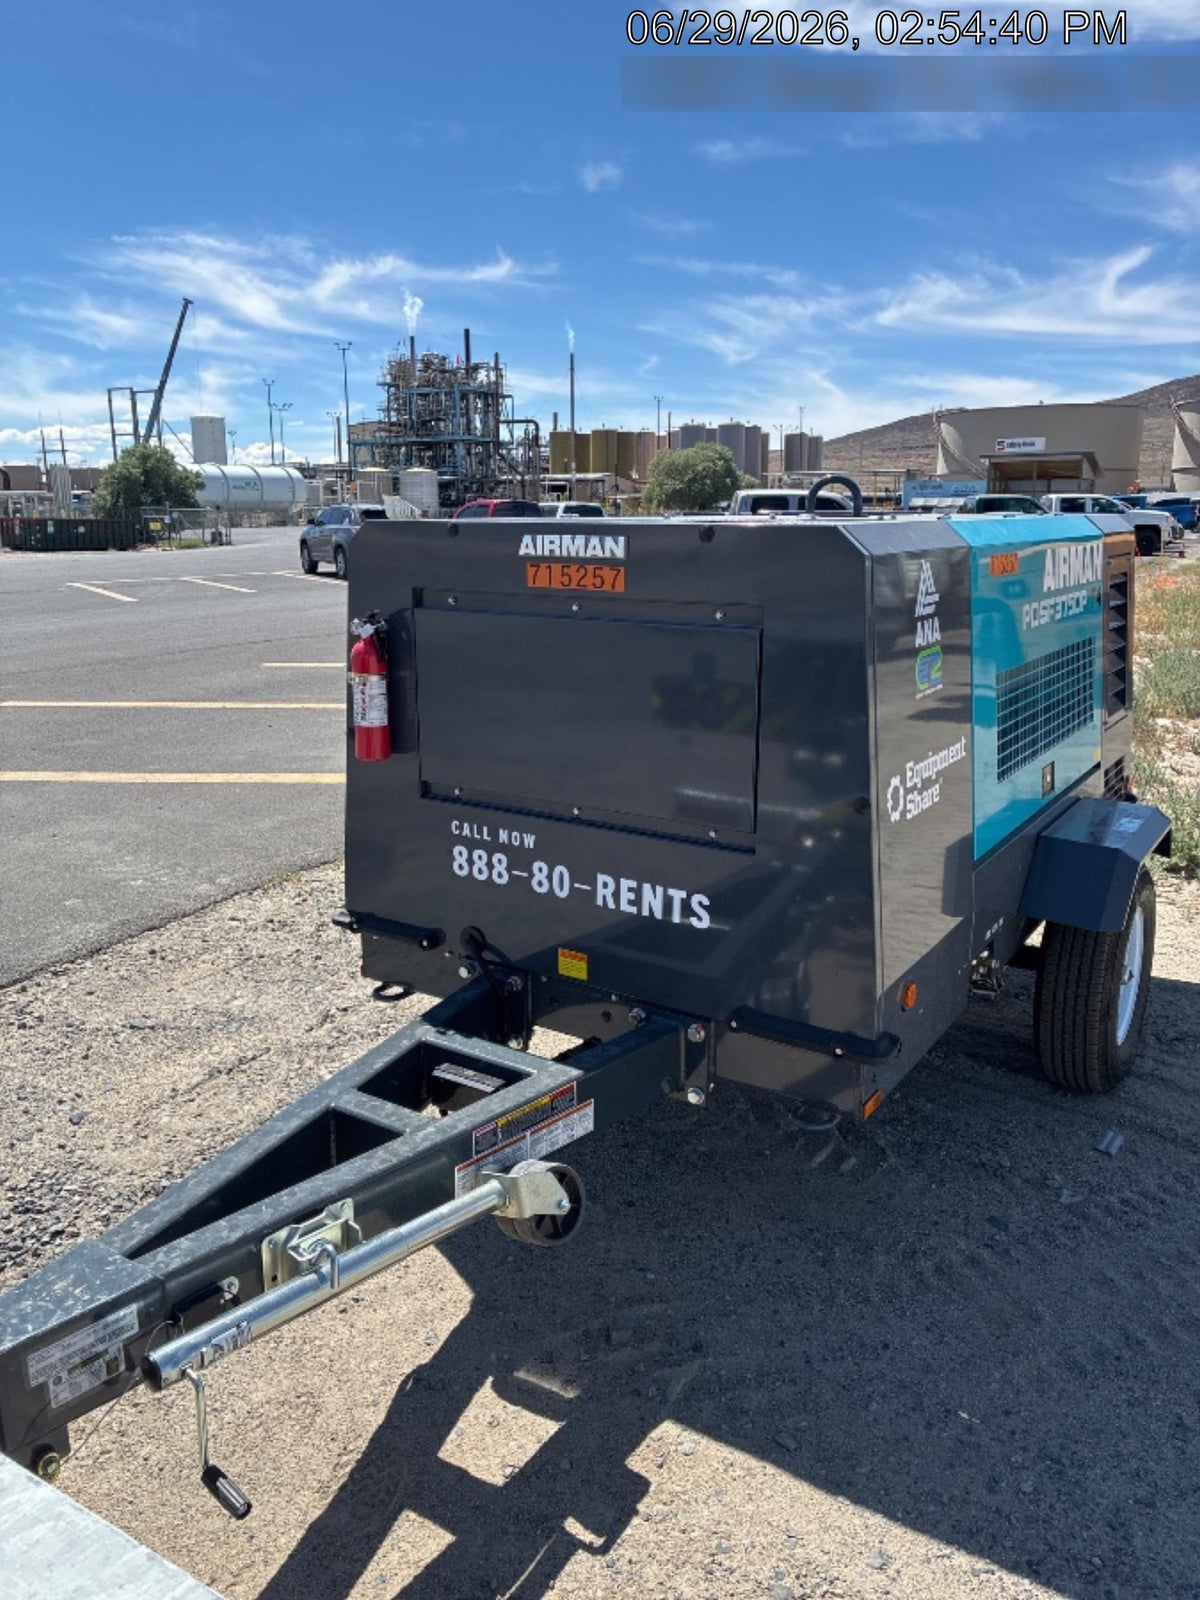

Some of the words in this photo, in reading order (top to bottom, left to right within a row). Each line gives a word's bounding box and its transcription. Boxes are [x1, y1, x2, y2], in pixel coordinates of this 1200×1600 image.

[518, 533, 626, 560] AIRMAN
[528, 563, 622, 591] 715257
[1043, 542, 1104, 592] AIRMAN
[915, 616, 942, 648] ANA
[905, 735, 967, 789] Equipment
[905, 782, 941, 822] Share
[451, 820, 492, 842] CALL
[499, 827, 536, 850] NOW
[452, 844, 711, 930] 888-80-RENTS
